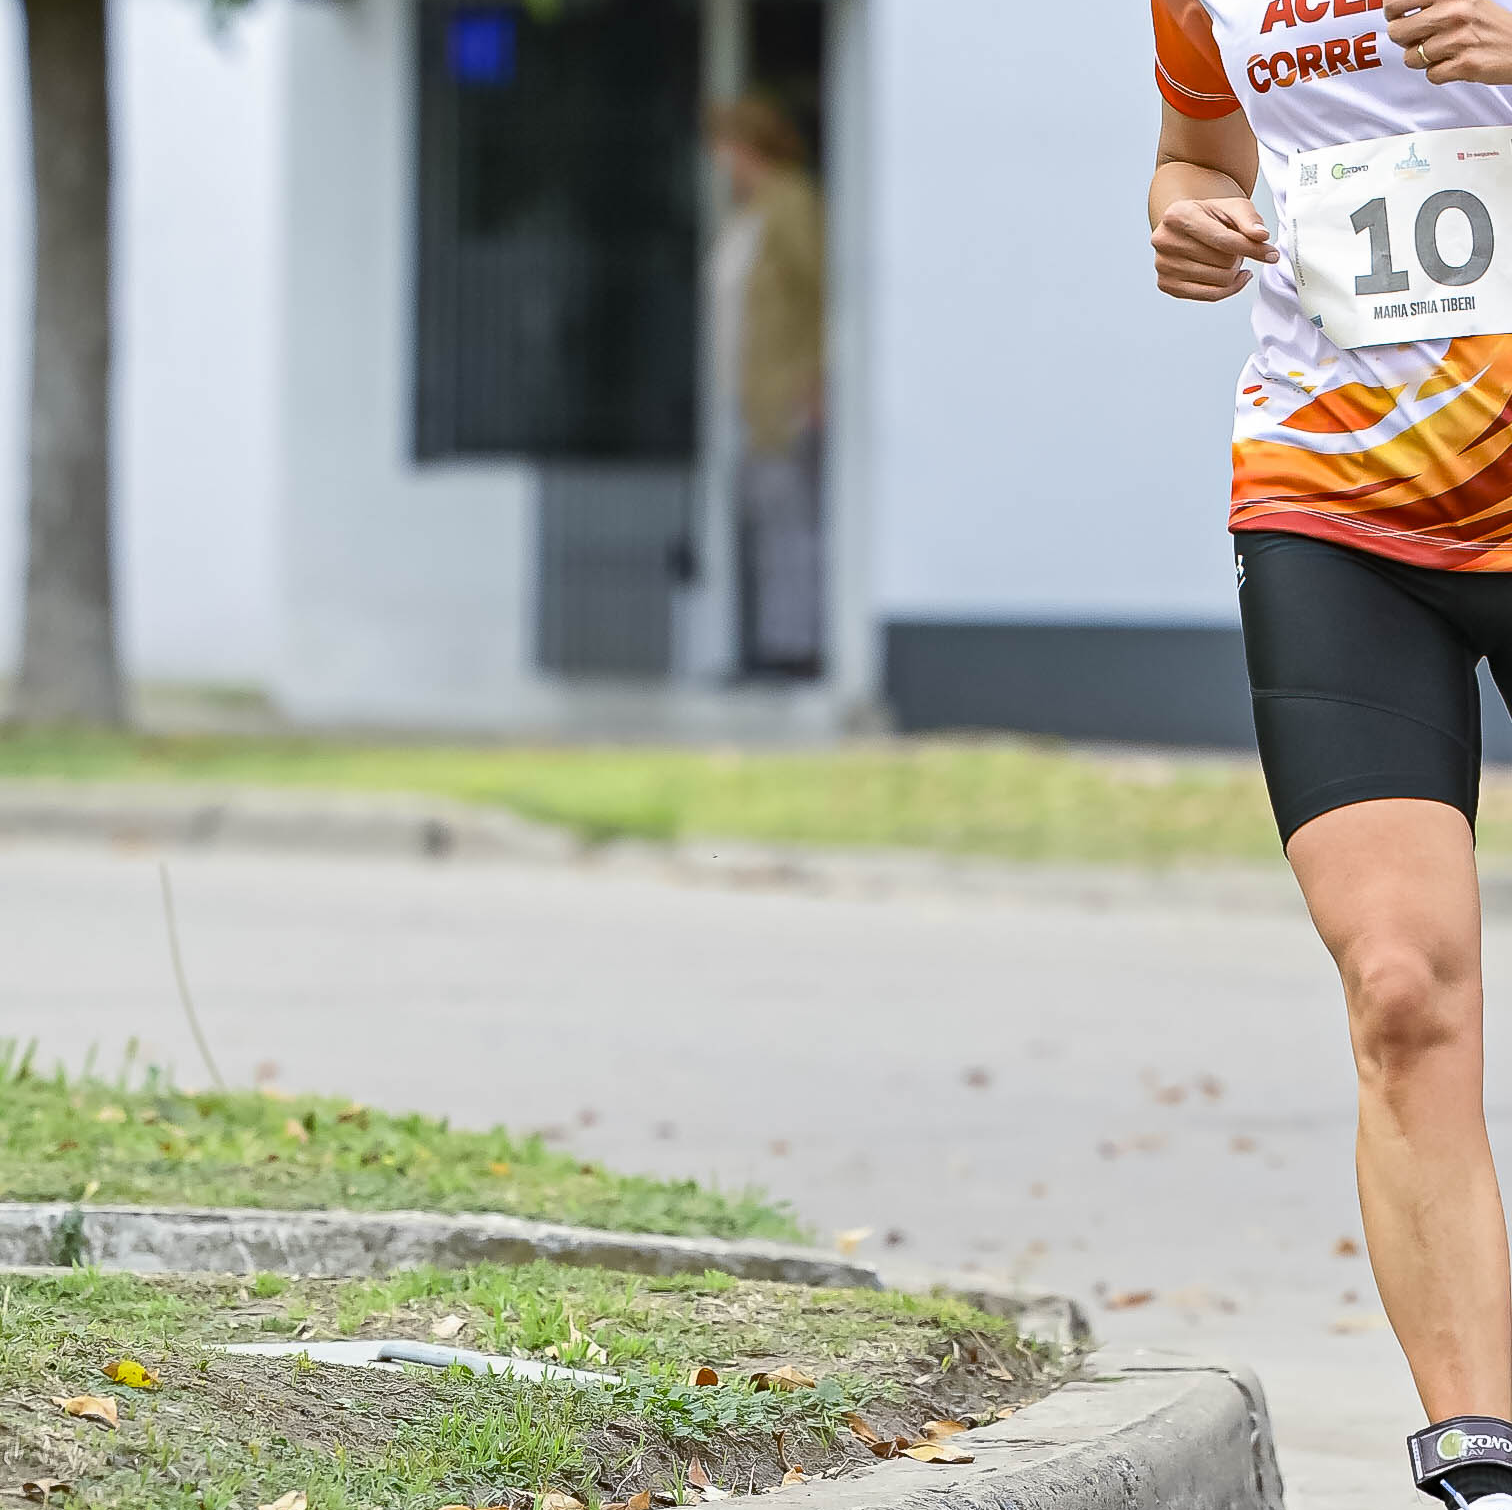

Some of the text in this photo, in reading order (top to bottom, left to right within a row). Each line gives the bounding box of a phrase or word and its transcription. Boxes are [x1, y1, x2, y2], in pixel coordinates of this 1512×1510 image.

[1247, 32, 1382, 93] CORRE
[1350, 189, 1495, 295] 10
[1373, 296, 1476, 320] MARIA SIRIA TIBERI
